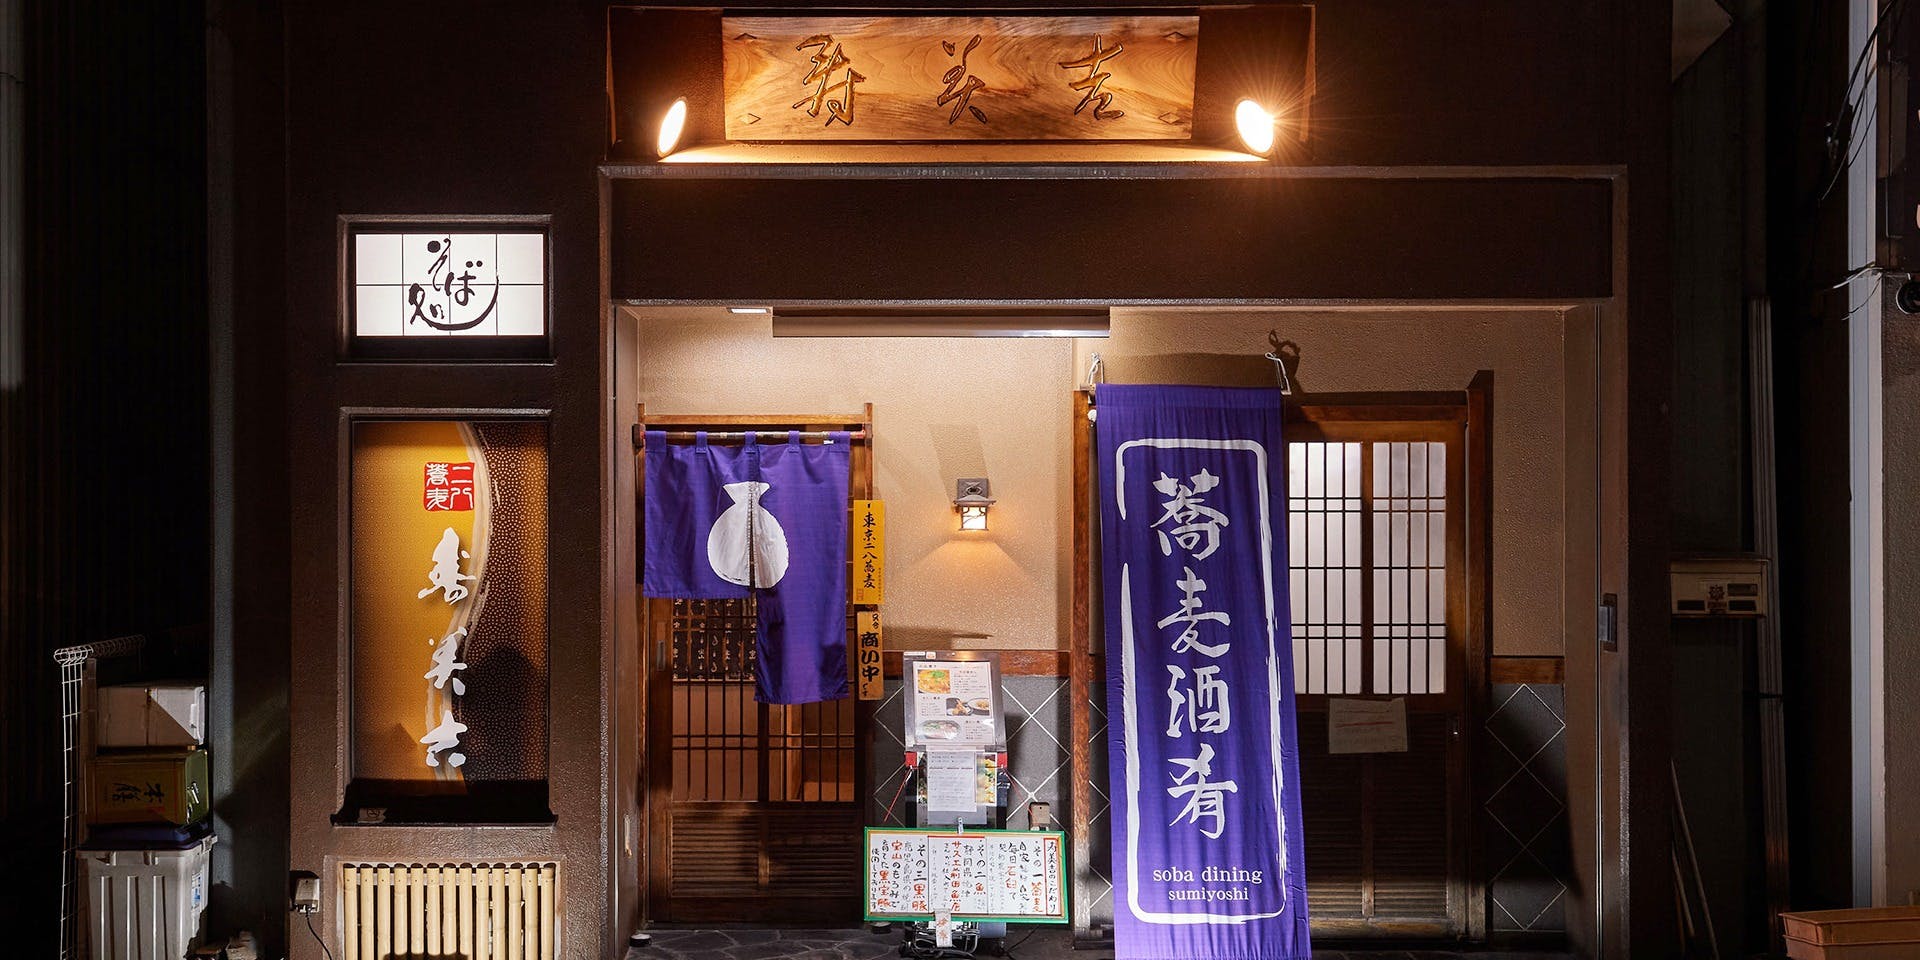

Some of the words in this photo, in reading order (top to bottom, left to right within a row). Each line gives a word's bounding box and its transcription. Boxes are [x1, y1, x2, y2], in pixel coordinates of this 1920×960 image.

[409, 238, 499, 331] そば処
[862, 512, 877, 589] 東京二八蕎麦
[1150, 467, 1238, 840] 蕎麦酒肴
[1153, 866, 1195, 882] soba
[1201, 866, 1263, 884] dining
[1168, 887, 1249, 902] sumiyoshi
